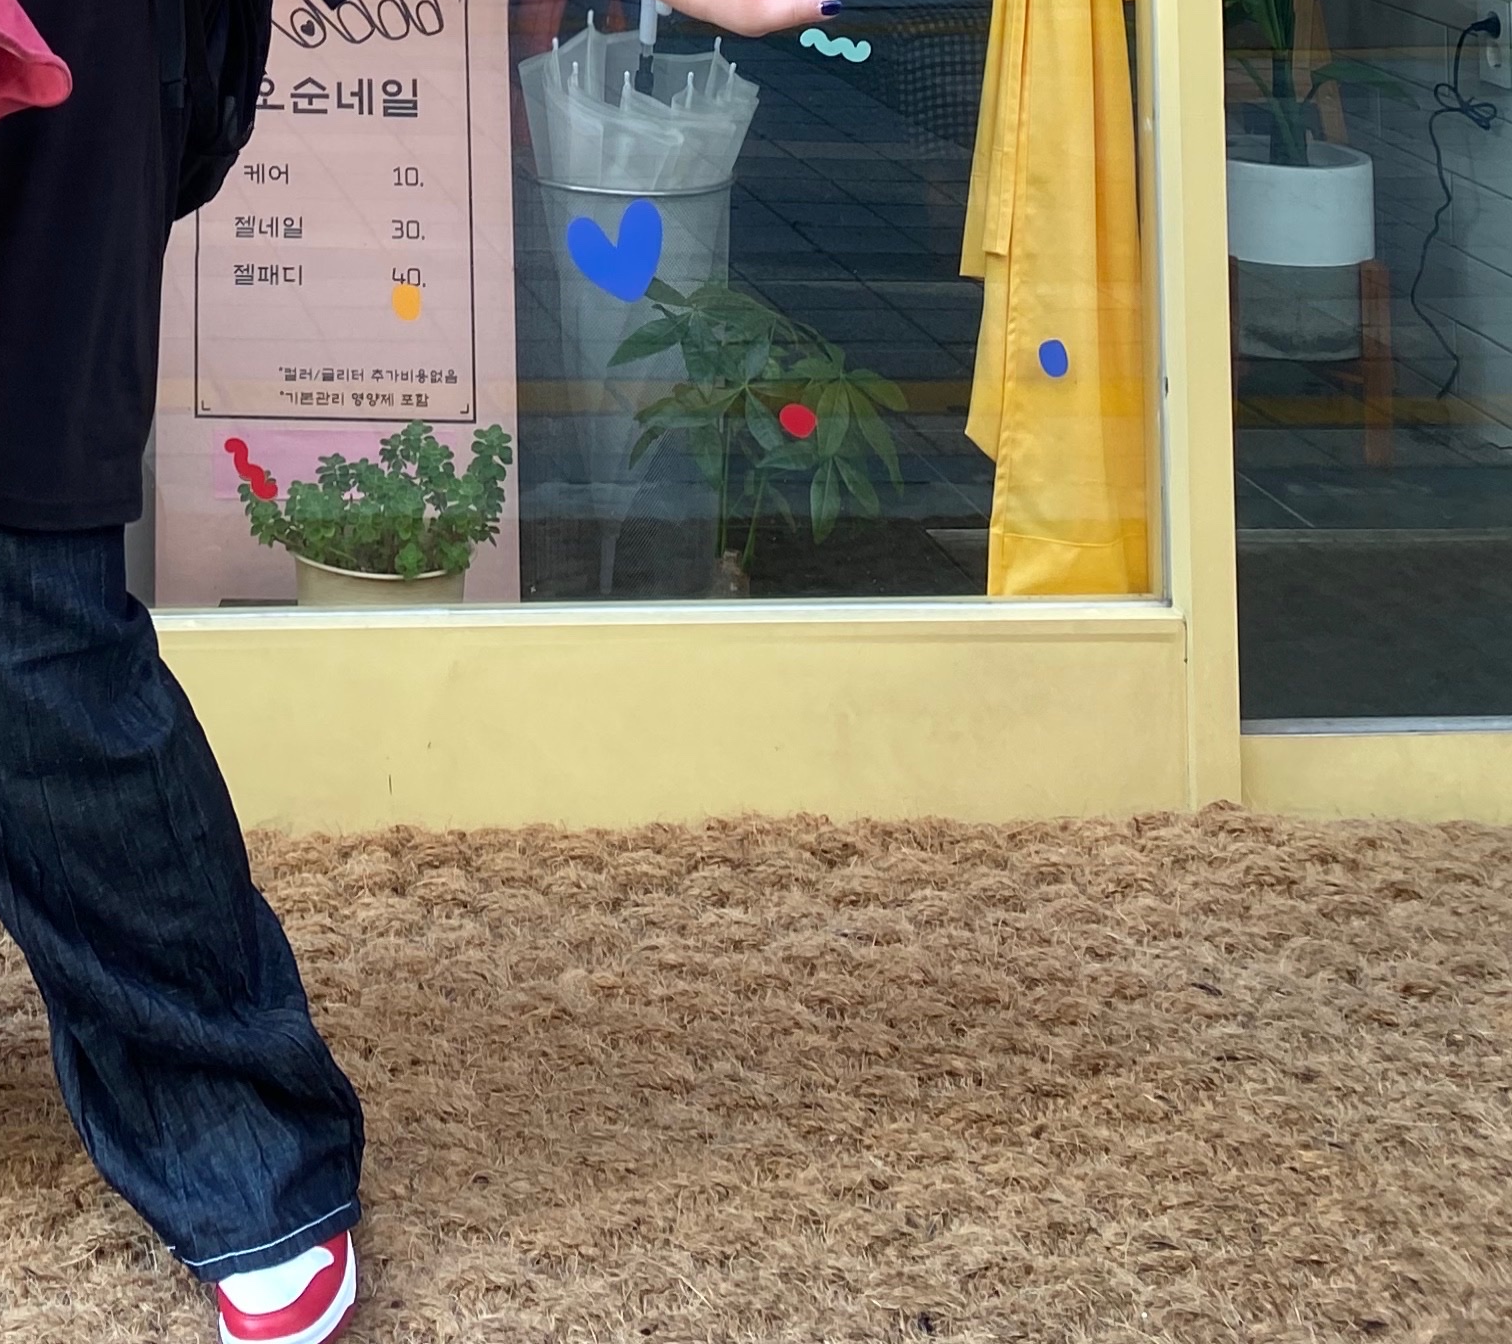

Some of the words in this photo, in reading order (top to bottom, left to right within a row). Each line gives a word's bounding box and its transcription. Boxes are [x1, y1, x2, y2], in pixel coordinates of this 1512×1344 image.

[256, 76, 419, 118] 오순네일
[244, 163, 289, 185] 케어
[392, 166, 424, 188] 10.
[234, 215, 303, 239] 젤네일
[391, 219, 425, 241] 30.
[233, 263, 303, 286] 젤패디
[391, 267, 426, 288] 40.
[370, 368, 459, 385] 추가비용없음
[351, 392, 395, 408] 영양제
[400, 393, 430, 408] 포함
